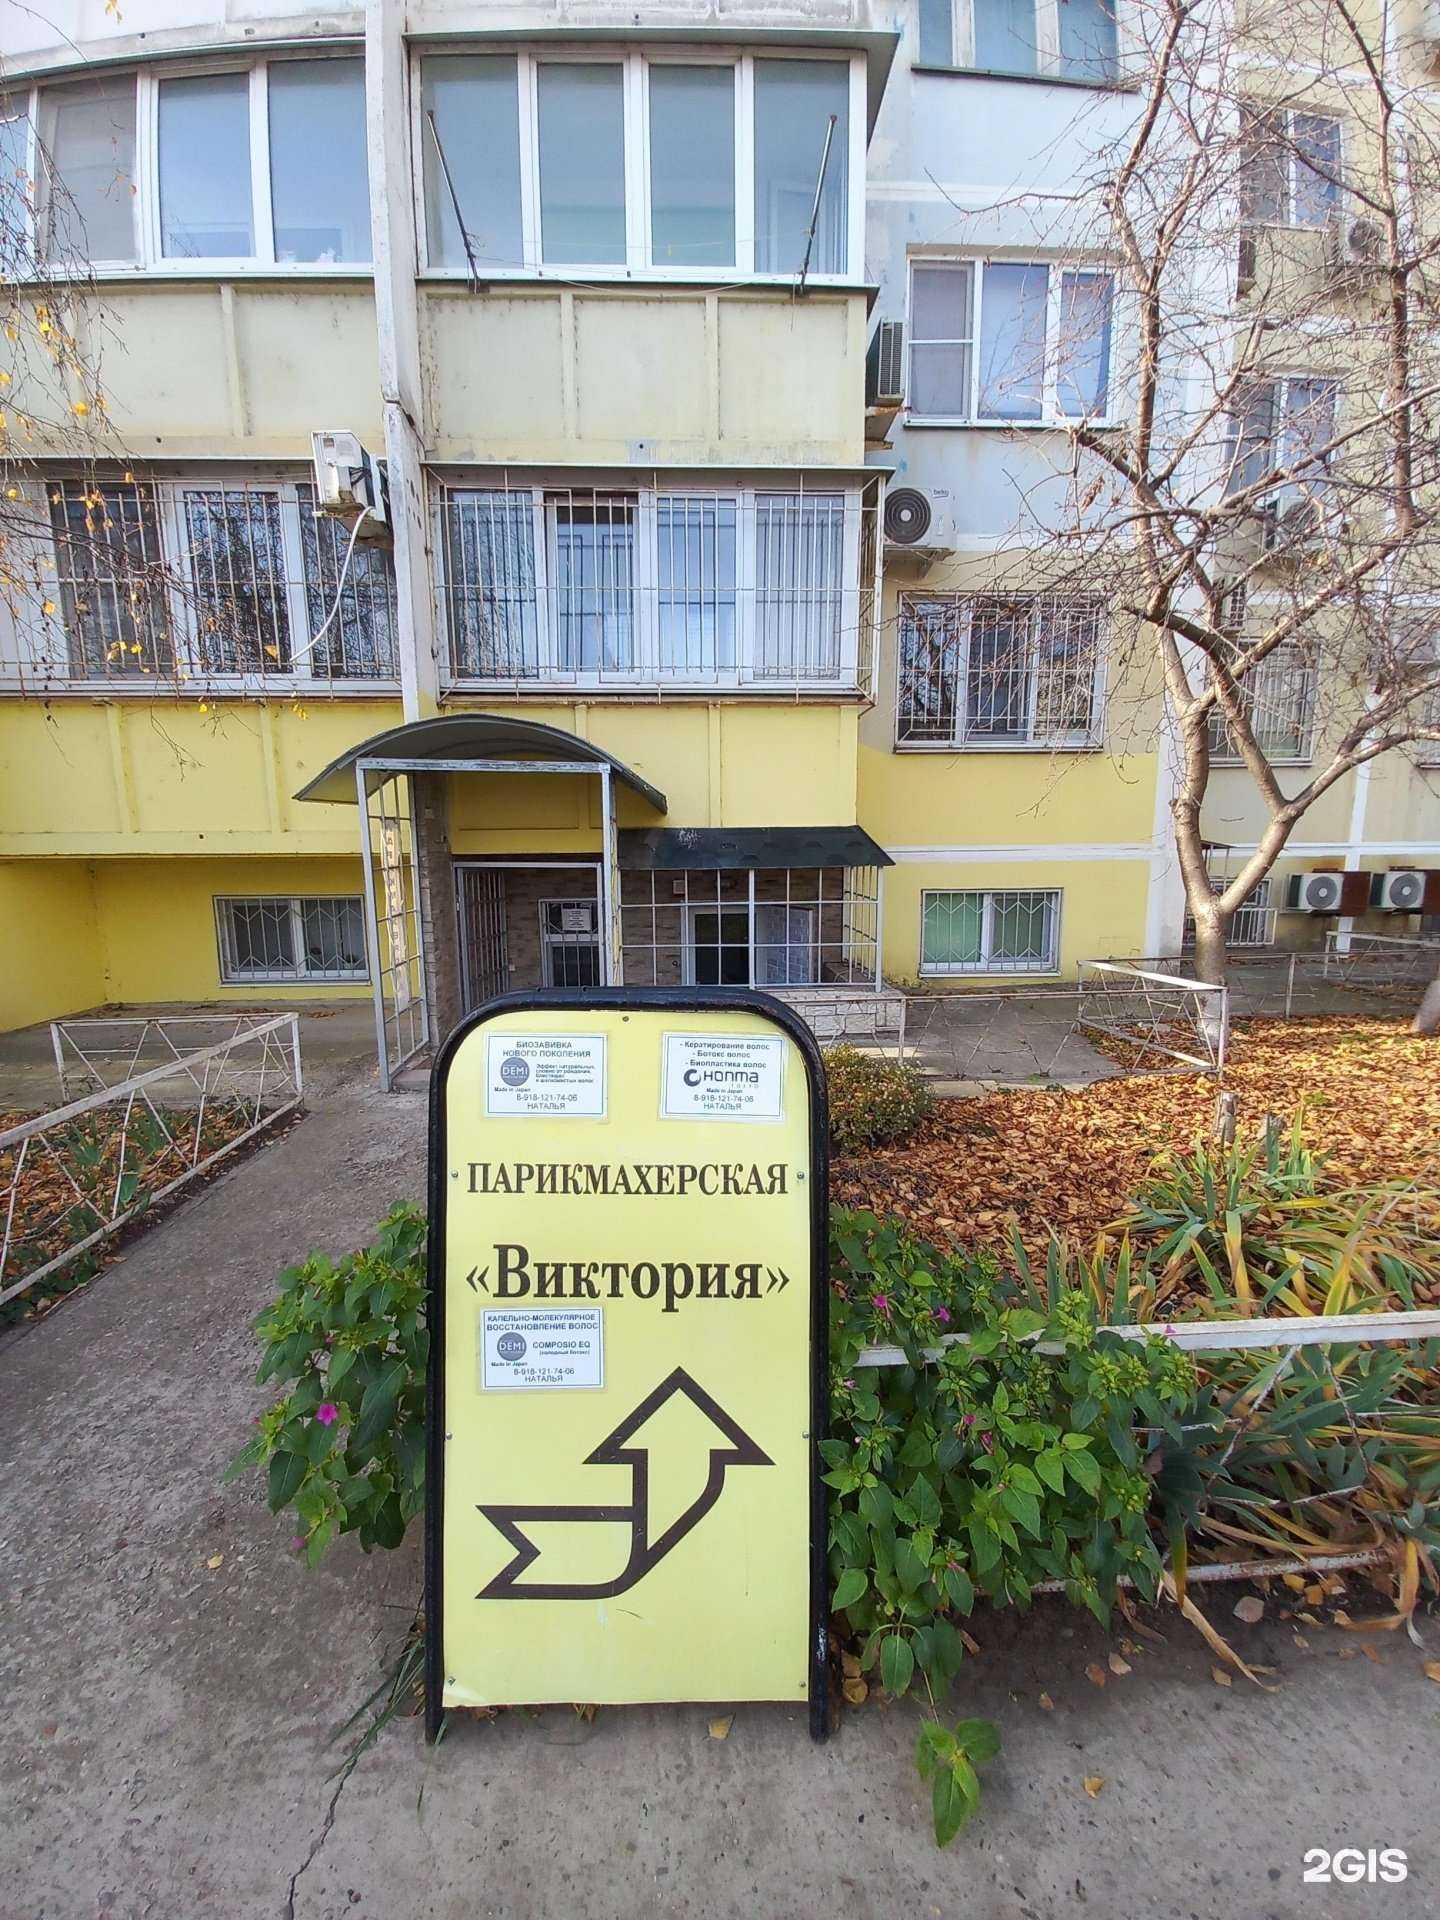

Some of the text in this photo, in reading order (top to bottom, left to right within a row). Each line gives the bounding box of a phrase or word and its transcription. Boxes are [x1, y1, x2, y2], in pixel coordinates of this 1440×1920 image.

[685, 1041, 744, 1050] Кератирование
[690, 1060, 740, 1068] Биопластика
[503, 1067, 528, 1076] DEMI
[467, 1162, 788, 1196] ПАРИКМАХЕРСКАЯ
[466, 1243, 790, 1313] «Виктория»
[499, 1342, 525, 1351] DEMI
